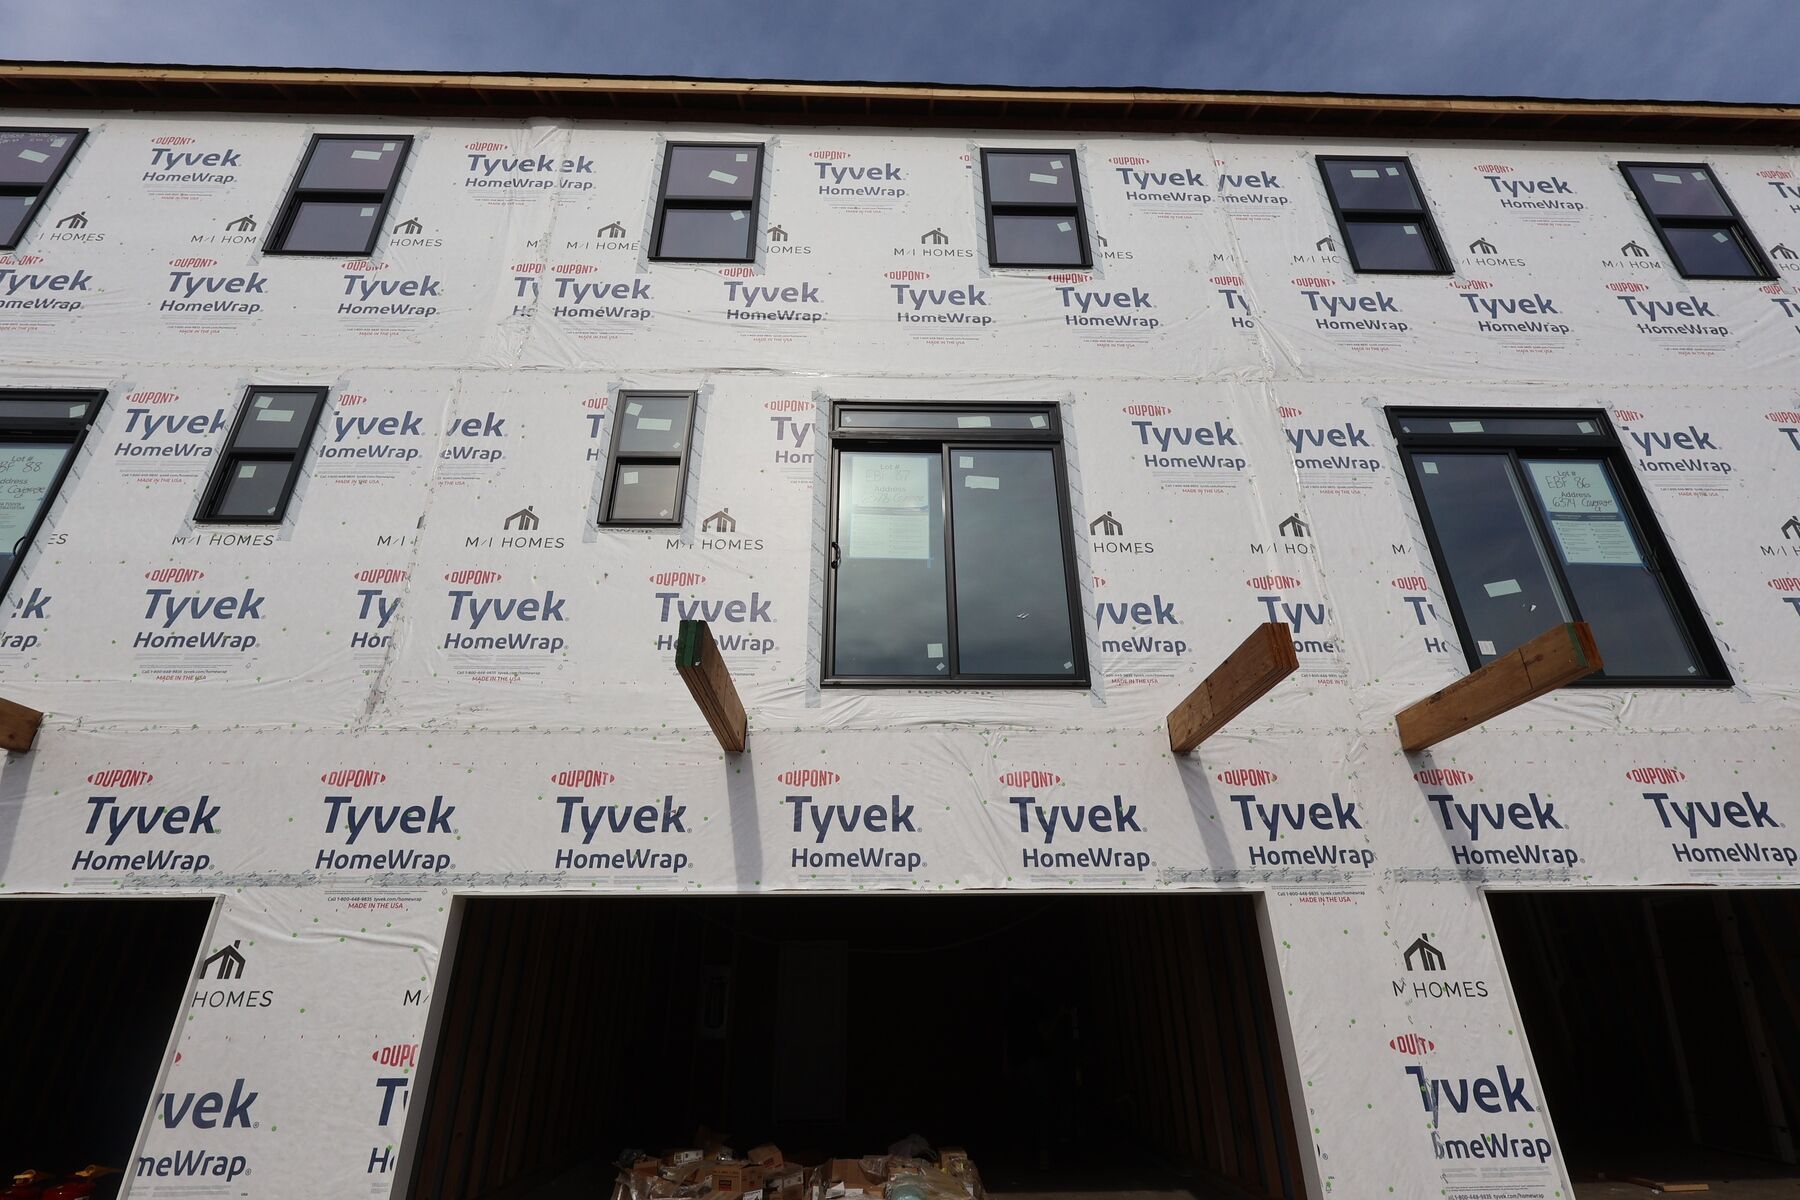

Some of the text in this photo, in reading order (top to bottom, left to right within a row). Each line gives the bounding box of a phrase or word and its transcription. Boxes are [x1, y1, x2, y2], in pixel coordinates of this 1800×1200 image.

[155, 137, 191, 145] DUPONT
[470, 142, 503, 151] DUPONT
[151, 148, 241, 170] Tyvek
[814, 150, 846, 160] DUPONT
[1114, 157, 1145, 165] DUPONT
[468, 154, 554, 176] Tyvek
[814, 162, 902, 184] Tyvek
[1478, 164, 1511, 174] DUPONT
[142, 172, 234, 184] HomeWrap
[465, 178, 553, 189] HomeWrap
[1116, 168, 1204, 189] Tyvek
[819, 186, 905, 198] HomeWrap
[1484, 176, 1573, 198] Tyvek
[1126, 191, 1211, 204] HomeWrap
[1501, 199, 1584, 211] HomeWrap
[50, 233, 105, 241] HOMES
[229, 235, 257, 243] HOM
[390, 239, 442, 247] HOMES
[596, 242, 639, 250] HOME
[894, 248, 973, 258] M/I HOMES
[174, 259, 213, 268] DUPONT
[557, 264, 593, 274] DUPONT
[1476, 258, 1526, 266] HOMES
[1630, 260, 1661, 269] HOM
[890, 271, 926, 280] DUPONT
[1297, 278, 1331, 287] DUPONT
[169, 272, 267, 298] Tyvek
[344, 274, 441, 301] Tyvek
[555, 278, 650, 304] Tyvek
[1610, 283, 1645, 292] DUPONT
[724, 281, 819, 307] Tyvek
[891, 284, 987, 310] Tyvek
[1055, 287, 1152, 313] Tyvek
[160, 300, 260, 314] HomeWrap
[337, 303, 437, 317] HomeWrap
[1301, 291, 1398, 317] Tyvek
[1460, 294, 1558, 319] Tyvek
[1617, 296, 1715, 321] Tyvek
[554, 306, 650, 320] HomeWrap
[727, 309, 822, 323] HomeWrap
[898, 313, 991, 326] HomeWrap
[1066, 315, 1159, 329] HomeWrap
[1316, 319, 1408, 332] HomeWrap
[1478, 321, 1569, 335] HomeWrap
[1637, 324, 1728, 337] HomeWrap
[132, 392, 174, 404] DUPONT
[771, 400, 810, 411] DUPONT
[1128, 405, 1166, 416] DUPONT
[334, 411, 423, 442] yvek
[1132, 421, 1237, 452] Tyvek
[1285, 423, 1370, 453] yvek
[1622, 426, 1717, 456] yvek
[114, 443, 212, 457] HomeWra
[1144, 455, 1246, 471] HomeWrap
[1295, 456, 1380, 472] omeWrap
[209, 533, 274, 546] HOMES
[377, 536, 405, 546] M/I
[465, 537, 564, 548] M/I HOMES
[702, 539, 763, 550] HOMES
[1094, 542, 1154, 555] HOMES
[1250, 543, 1277, 555] M/I
[1760, 545, 1787, 556] M/I
[151, 569, 199, 583] DUPONT
[361, 569, 407, 583] DUPONT
[451, 570, 496, 584] DUPONT
[656, 572, 700, 586] DUPONT
[1253, 577, 1294, 590] DUPONT
[145, 588, 265, 628] Tyvek
[448, 591, 565, 629] Tyvek
[133, 632, 256, 651] HomeWrap
[444, 633, 563, 653] HomeWrap
[1102, 637, 1187, 655] meWrap
[95, 769, 148, 787] DUPONT
[328, 769, 380, 787] DUPONT
[559, 770, 610, 788] DUPONT
[785, 770, 835, 788] DUPONT
[1006, 771, 1056, 788] DUPONT
[1223, 769, 1272, 786] DUPONT
[1420, 769, 1468, 786] DUPONT
[1633, 768, 1679, 784] DUPONT
[86, 796, 221, 845] Tyvek
[324, 796, 455, 845] Tyvek
[557, 795, 686, 844] Tyvek
[786, 795, 915, 843] Tyvek
[1010, 795, 1141, 844] Tyvek
[1230, 793, 1363, 841] Tyvek
[1427, 793, 1563, 841] Tyvek
[1642, 792, 1779, 839] Tyvek
[72, 850, 210, 873] HomeWrap
[315, 850, 450, 871] HomeWrap
[556, 850, 688, 872] HomeWrap
[792, 848, 921, 872] HomeWrap
[1023, 848, 1150, 871] HomeWrap
[1248, 846, 1374, 868] HomeWrap
[1451, 845, 1578, 868] HomeWrap
[1672, 843, 1797, 866] HomeWrap
[1413, 981, 1488, 998] HOMES
[192, 991, 273, 1008] HOMES
